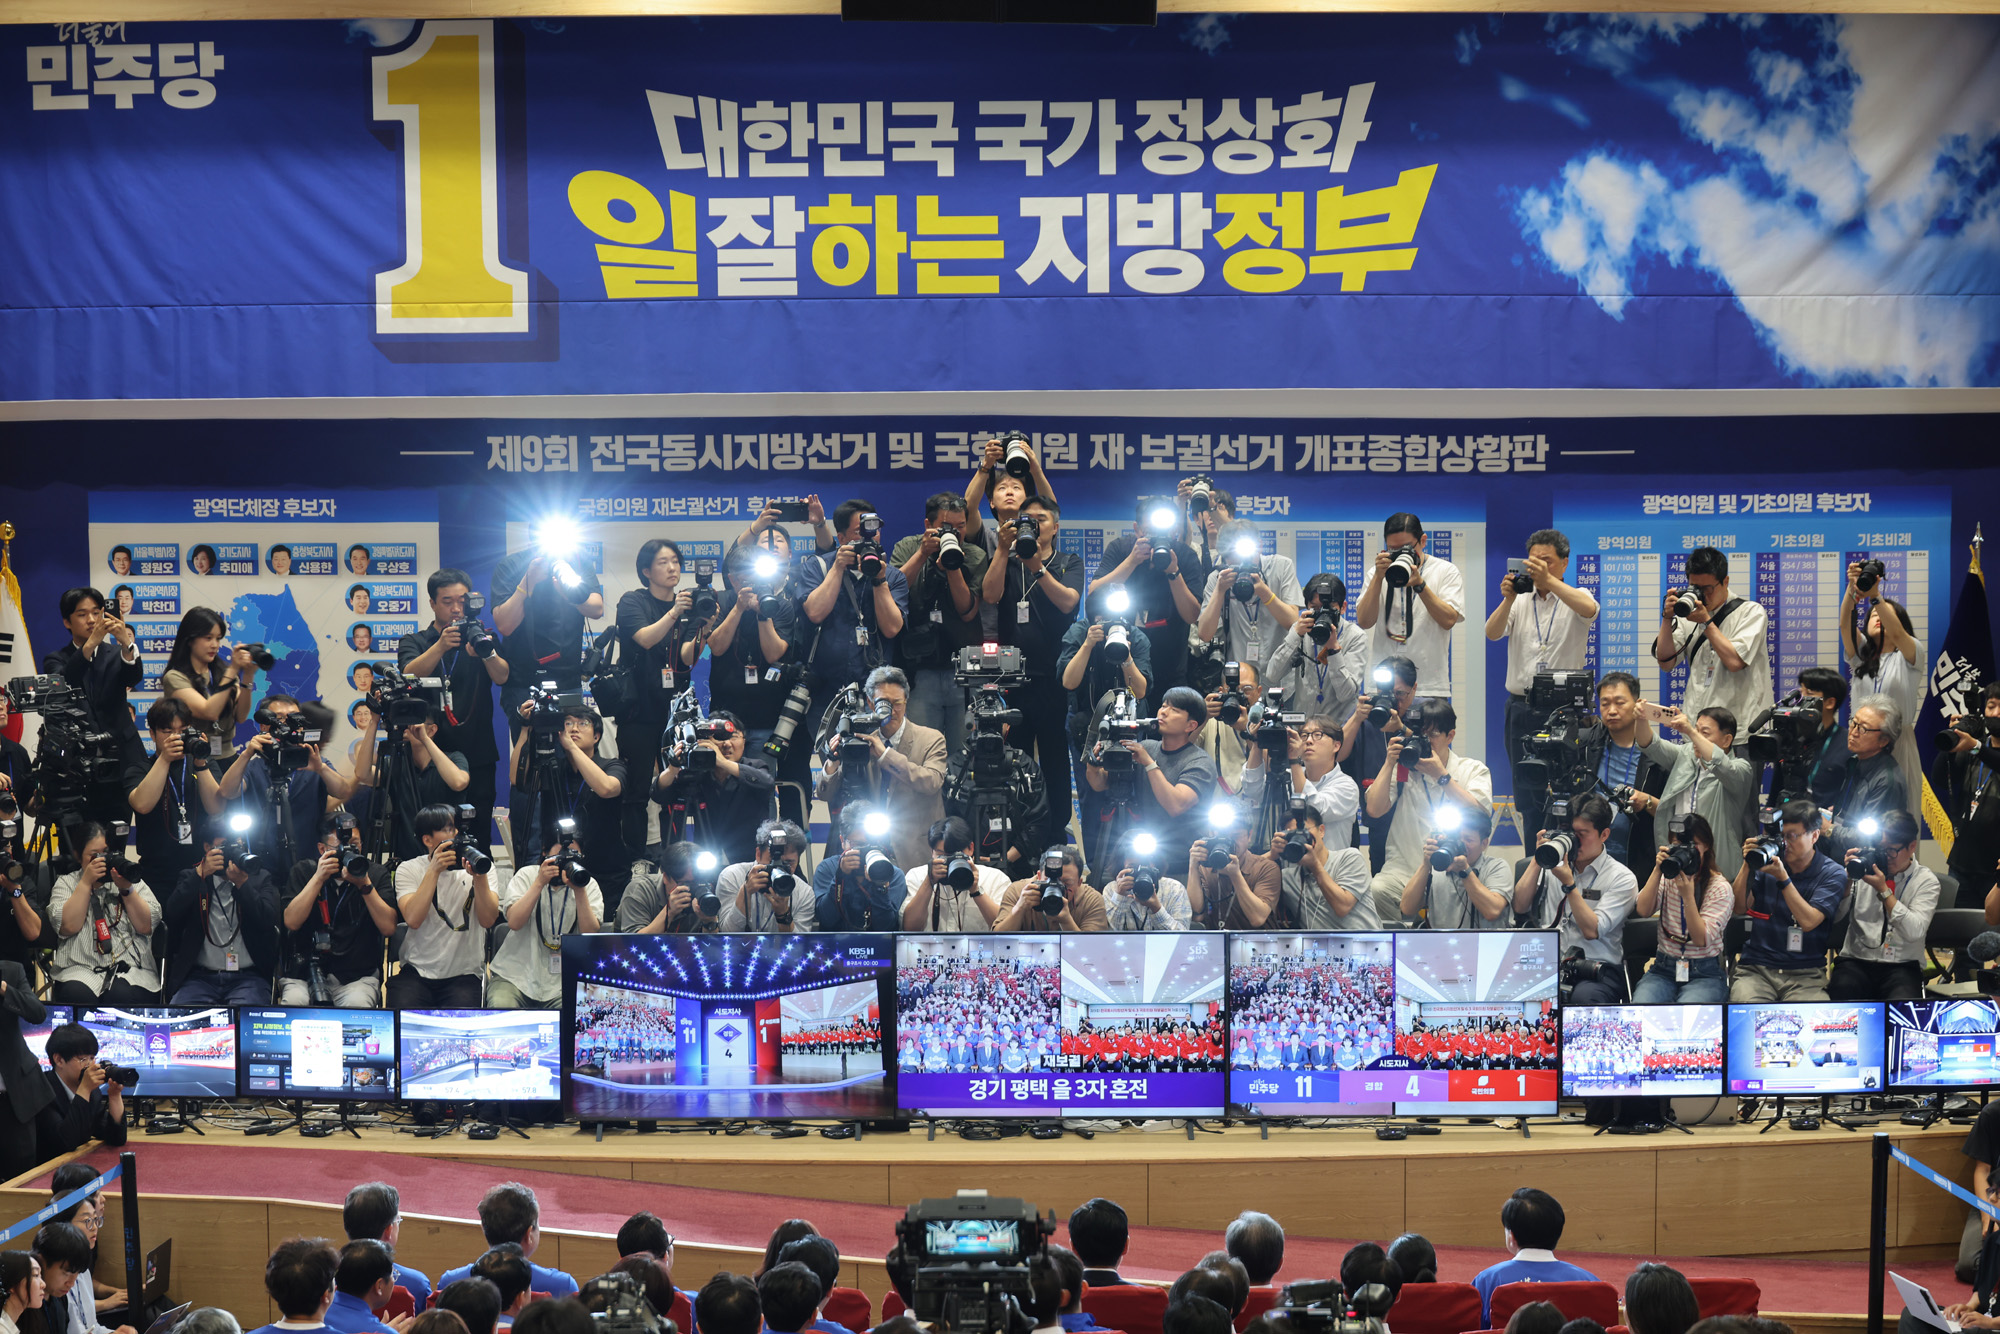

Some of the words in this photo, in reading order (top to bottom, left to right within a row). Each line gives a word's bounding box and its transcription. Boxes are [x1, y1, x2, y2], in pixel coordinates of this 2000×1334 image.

[26, 41, 224, 111] 민주당
[645, 88, 959, 178] 대한민국
[975, 99, 1122, 177] 국가
[1134, 80, 1377, 175] 정상화
[371, 19, 529, 334] 1
[567, 169, 699, 300] 일
[1015, 163, 1439, 295] 지방정부
[486, 434, 578, 473] 제9회
[590, 432, 877, 473] 전국동시지방선거
[888, 433, 923, 470] 및
[1090, 433, 1288, 473] 재·보궐선거
[1295, 434, 1550, 473] 개표종합상황판
[193, 498, 280, 518] 광역단체장
[283, 498, 337, 518] 후보자
[579, 497, 648, 517] 국회의원
[652, 496, 739, 516] 재보궐선거
[1235, 496, 1291, 515] 후보자
[1643, 494, 1715, 515] 광역의원
[1718, 494, 1737, 514] 및
[1741, 493, 1813, 513] 기초의원
[1816, 492, 1872, 513] 후보자
[1598, 535, 1652, 550] 광역의원
[1682, 535, 1737, 549] 광역비례
[1770, 533, 1825, 548] 기초의원
[1858, 533, 1912, 547] 기초비례
[141, 562, 174, 574] 정원오
[220, 562, 253, 574] 추미애
[299, 562, 332, 574] 신용한
[377, 562, 410, 574] 우상호
[1581, 563, 1596, 573] 서울
[1760, 561, 1776, 570] 서울
[1760, 573, 1776, 582] 부산
[135, 585, 178, 597] 인천광역시장
[1760, 585, 1776, 594] 대구
[142, 601, 175, 613] 박찬대
[378, 600, 411, 612] 오중기
[379, 639, 399, 651] 김부
[1670, 668, 1686, 677] 강원
[99, 921, 109, 937] PRESS
[1188, 945, 1209, 955] SBS
[714, 1007, 742, 1016] 시도지사
[683, 1027, 696, 1044] 11
[760, 1026, 767, 1043] 1
[725, 1049, 732, 1058] 4
[1378, 1059, 1409, 1068] 시도지사
[969, 1078, 1007, 1100] 경기
[1010, 1078, 1048, 1100] 평택
[1051, 1078, 1072, 1100] 을
[1075, 1078, 1108, 1100] 3자
[1110, 1078, 1148, 1100] 혼전
[1249, 1083, 1279, 1094] 민주당
[1295, 1075, 1312, 1098] 11
[1365, 1081, 1384, 1092] 경합
[1406, 1075, 1420, 1097] 4
[1517, 1074, 1526, 1097] 1
